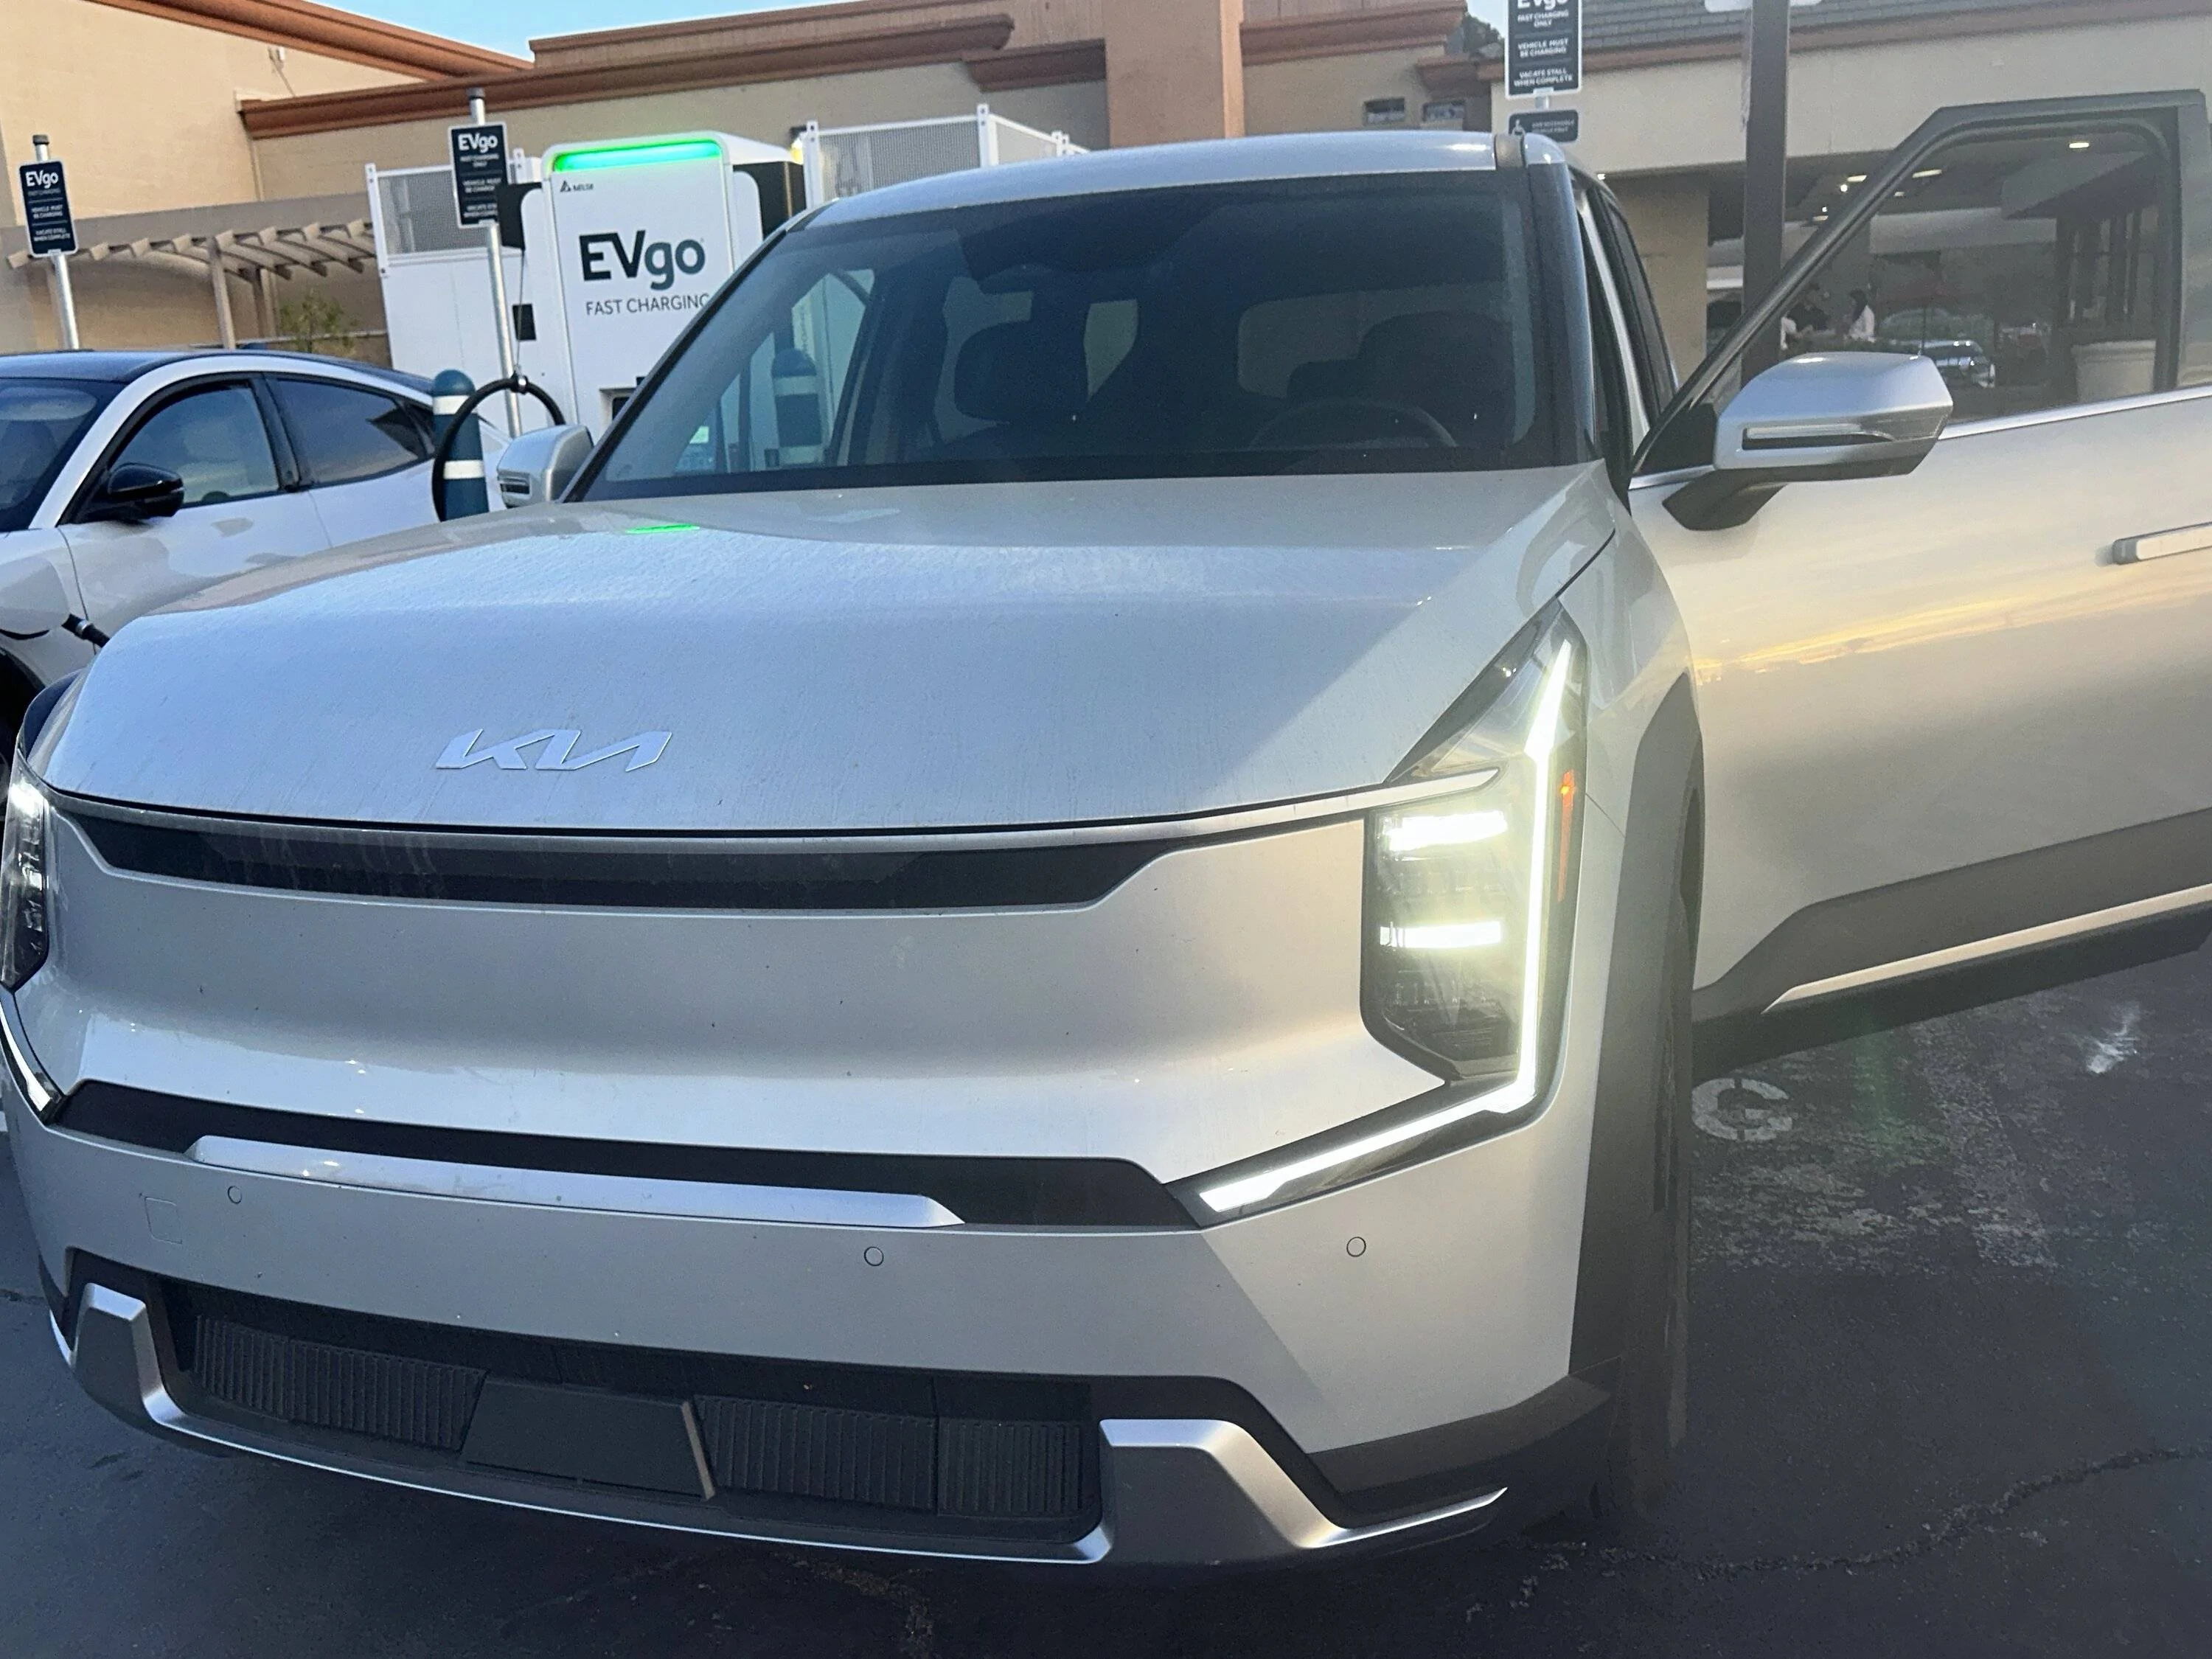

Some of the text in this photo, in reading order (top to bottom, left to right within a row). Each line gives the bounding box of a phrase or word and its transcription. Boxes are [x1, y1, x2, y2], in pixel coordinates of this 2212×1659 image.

[458, 133, 498, 153] EVgo
[25, 170, 59, 189] EVgo
[579, 229, 706, 291] EVgo
[586, 299, 622, 315] FAST
[436, 728, 672, 772] KIA
